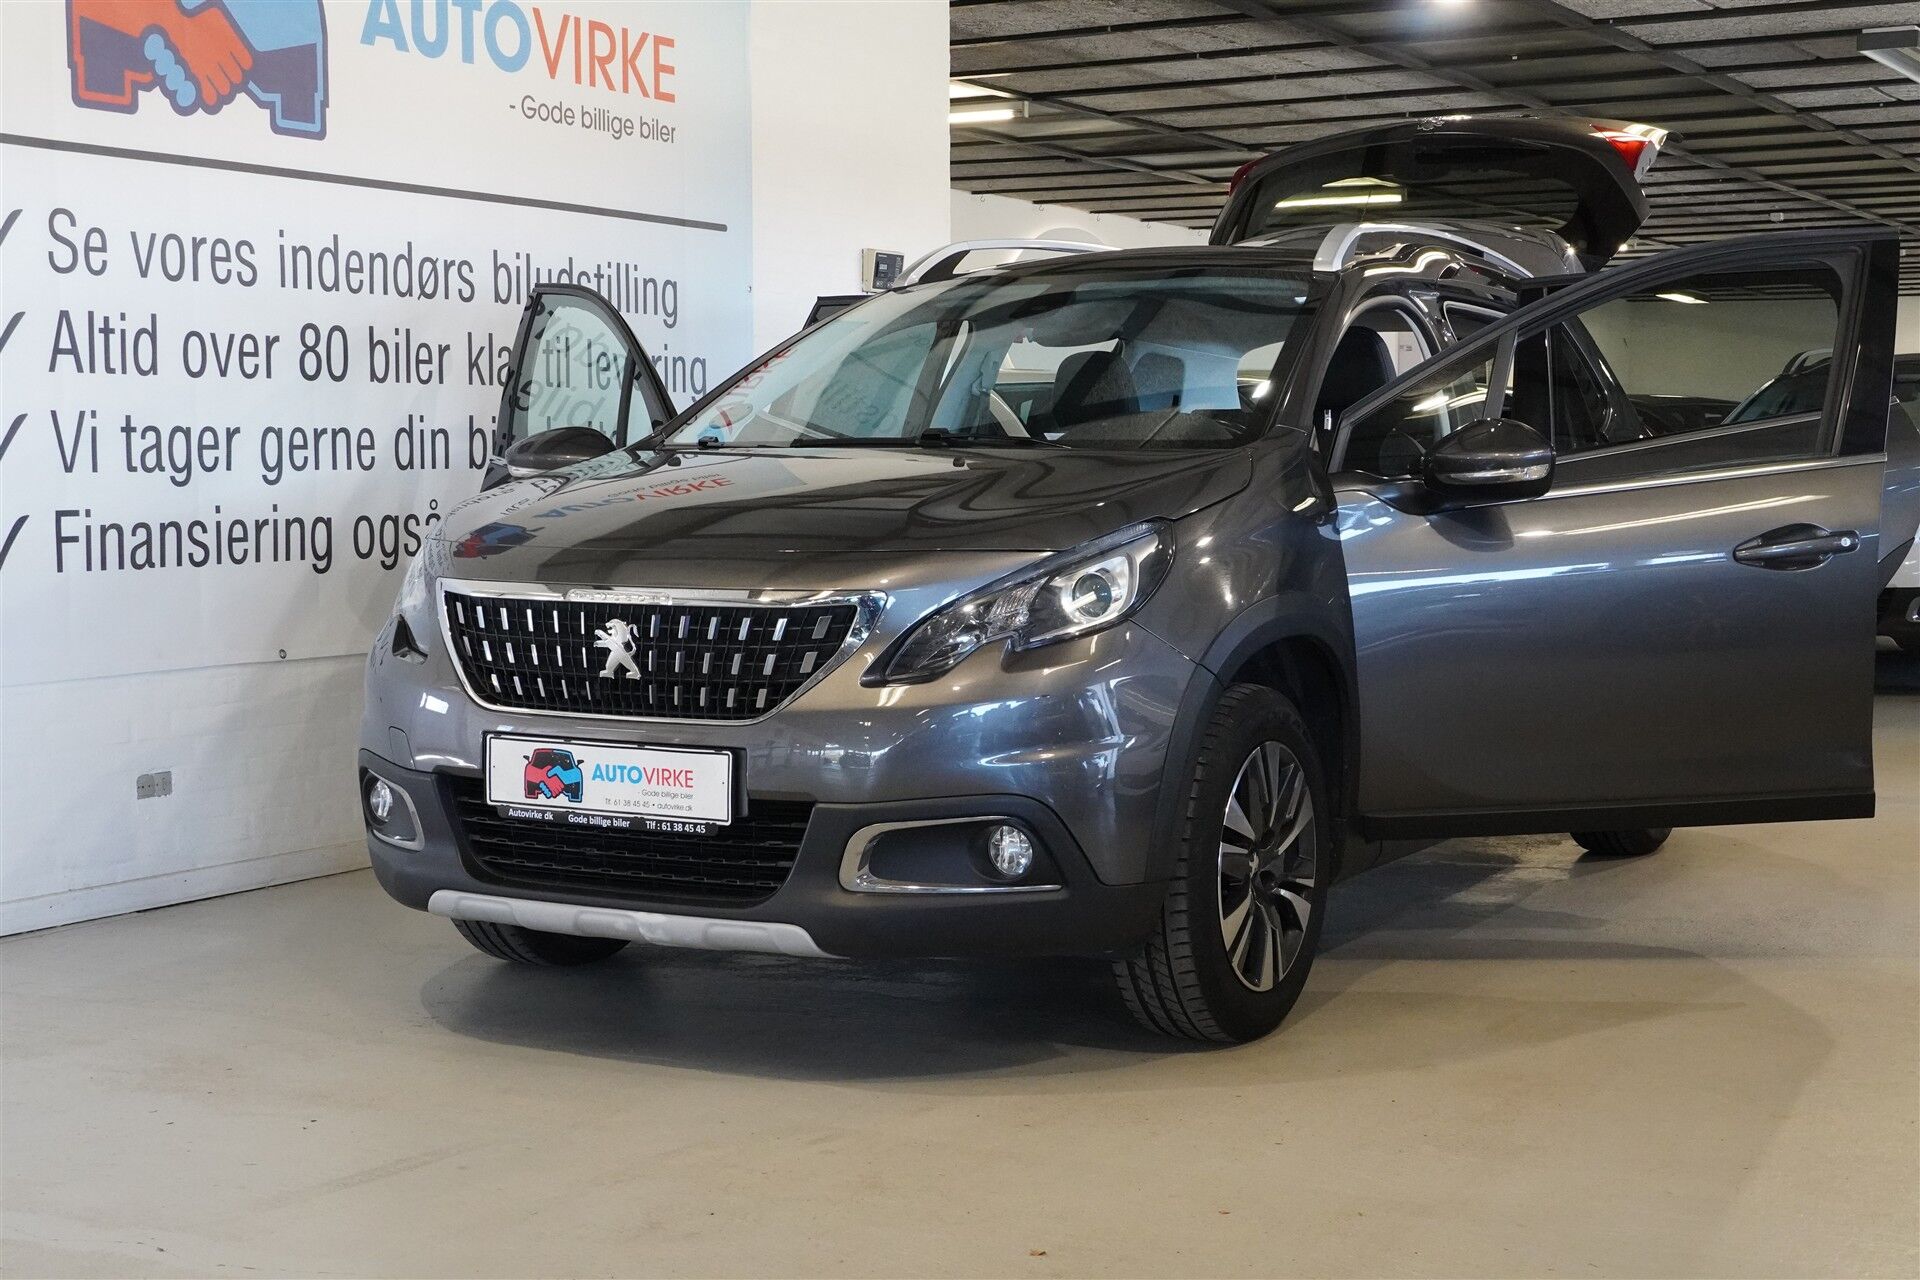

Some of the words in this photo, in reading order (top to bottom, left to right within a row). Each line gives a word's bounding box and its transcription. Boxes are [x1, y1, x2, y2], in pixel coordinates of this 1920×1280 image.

[360, 0, 676, 104] AUTOVIRKE
[521, 95, 575, 126] Gode
[581, 105, 635, 140] billige
[640, 116, 676, 144] biler
[48, 207, 108, 276] Se
[130, 231, 258, 287] vores
[279, 229, 475, 303] indendørs
[48, 310, 158, 376] Altid
[182, 330, 280, 380] over
[299, 322, 349, 383] 80
[369, 325, 451, 385] biler
[467, 331, 512, 387] kla
[542, 335, 571, 388] til
[587, 338, 707, 404] levring
[50, 410, 98, 473] Vi
[121, 414, 241, 487] tager
[260, 425, 376, 486] gerne
[394, 414, 450, 471] din
[469, 414, 497, 470] bi
[55, 503, 333, 574] Finansiering
[591, 763, 694, 789] AUTOVIRKE
[641, 788, 660, 798] Gode
[568, 814, 587, 824] Gode
[589, 815, 611, 827] billige
[612, 818, 630, 827] biler
[661, 822, 671, 831] 61
[673, 823, 682, 832] 38
[684, 824, 694, 833] 45
[695, 825, 706, 834] 45
